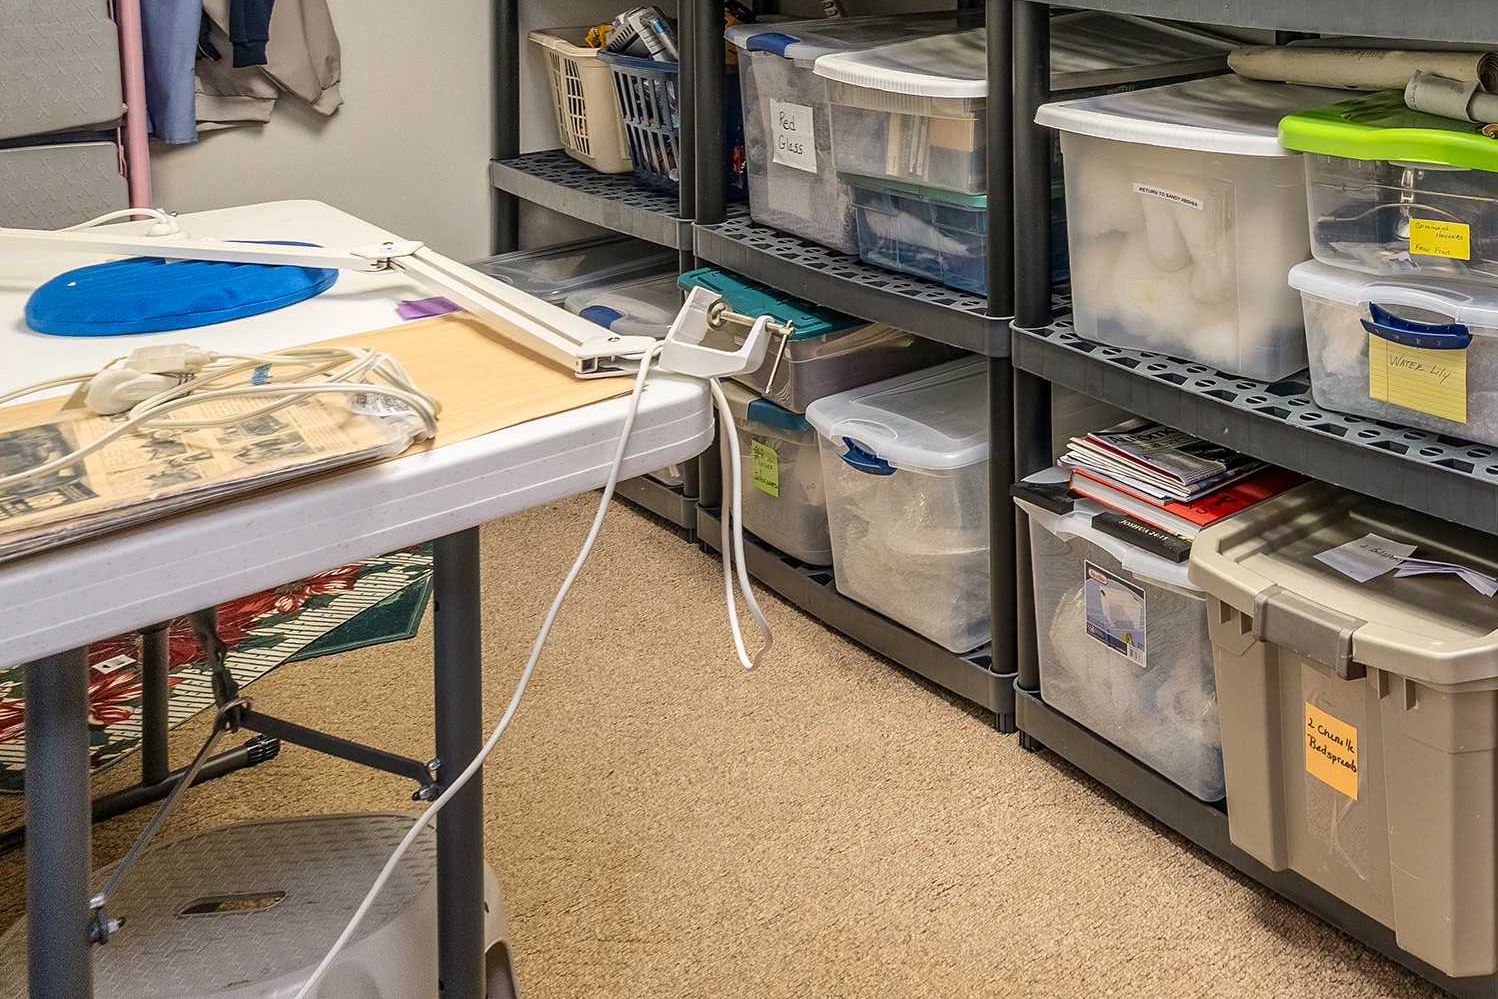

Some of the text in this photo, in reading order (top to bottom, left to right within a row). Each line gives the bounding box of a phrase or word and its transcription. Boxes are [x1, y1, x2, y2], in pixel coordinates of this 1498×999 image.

[779, 111, 796, 131] Red
[778, 134, 804, 155] Glass
[1138, 186, 1158, 196] RETURN
[1389, 353, 1425, 372] WATER
[1118, 519, 1150, 535] JOSHUA
[1307, 717, 1314, 728] 2
[1307, 734, 1358, 774] Bedspreads
